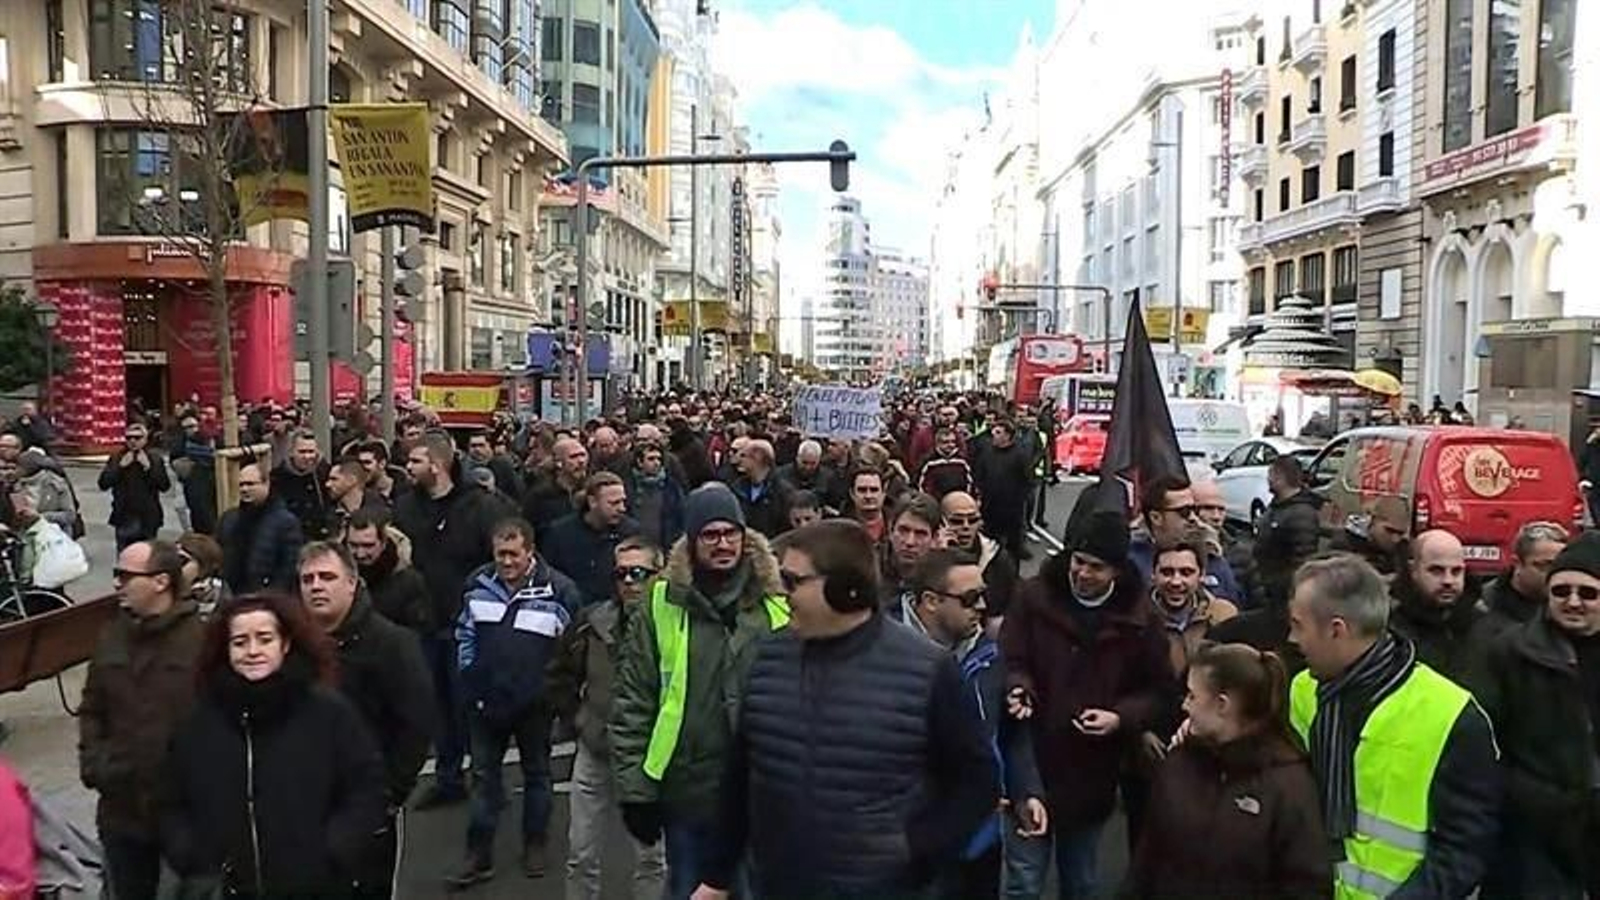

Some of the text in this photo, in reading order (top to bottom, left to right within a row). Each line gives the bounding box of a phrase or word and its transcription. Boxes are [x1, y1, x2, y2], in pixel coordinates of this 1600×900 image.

[342, 131, 367, 146] SAN
[346, 146, 393, 162] REGALA
[1080, 383, 1116, 398] makro
